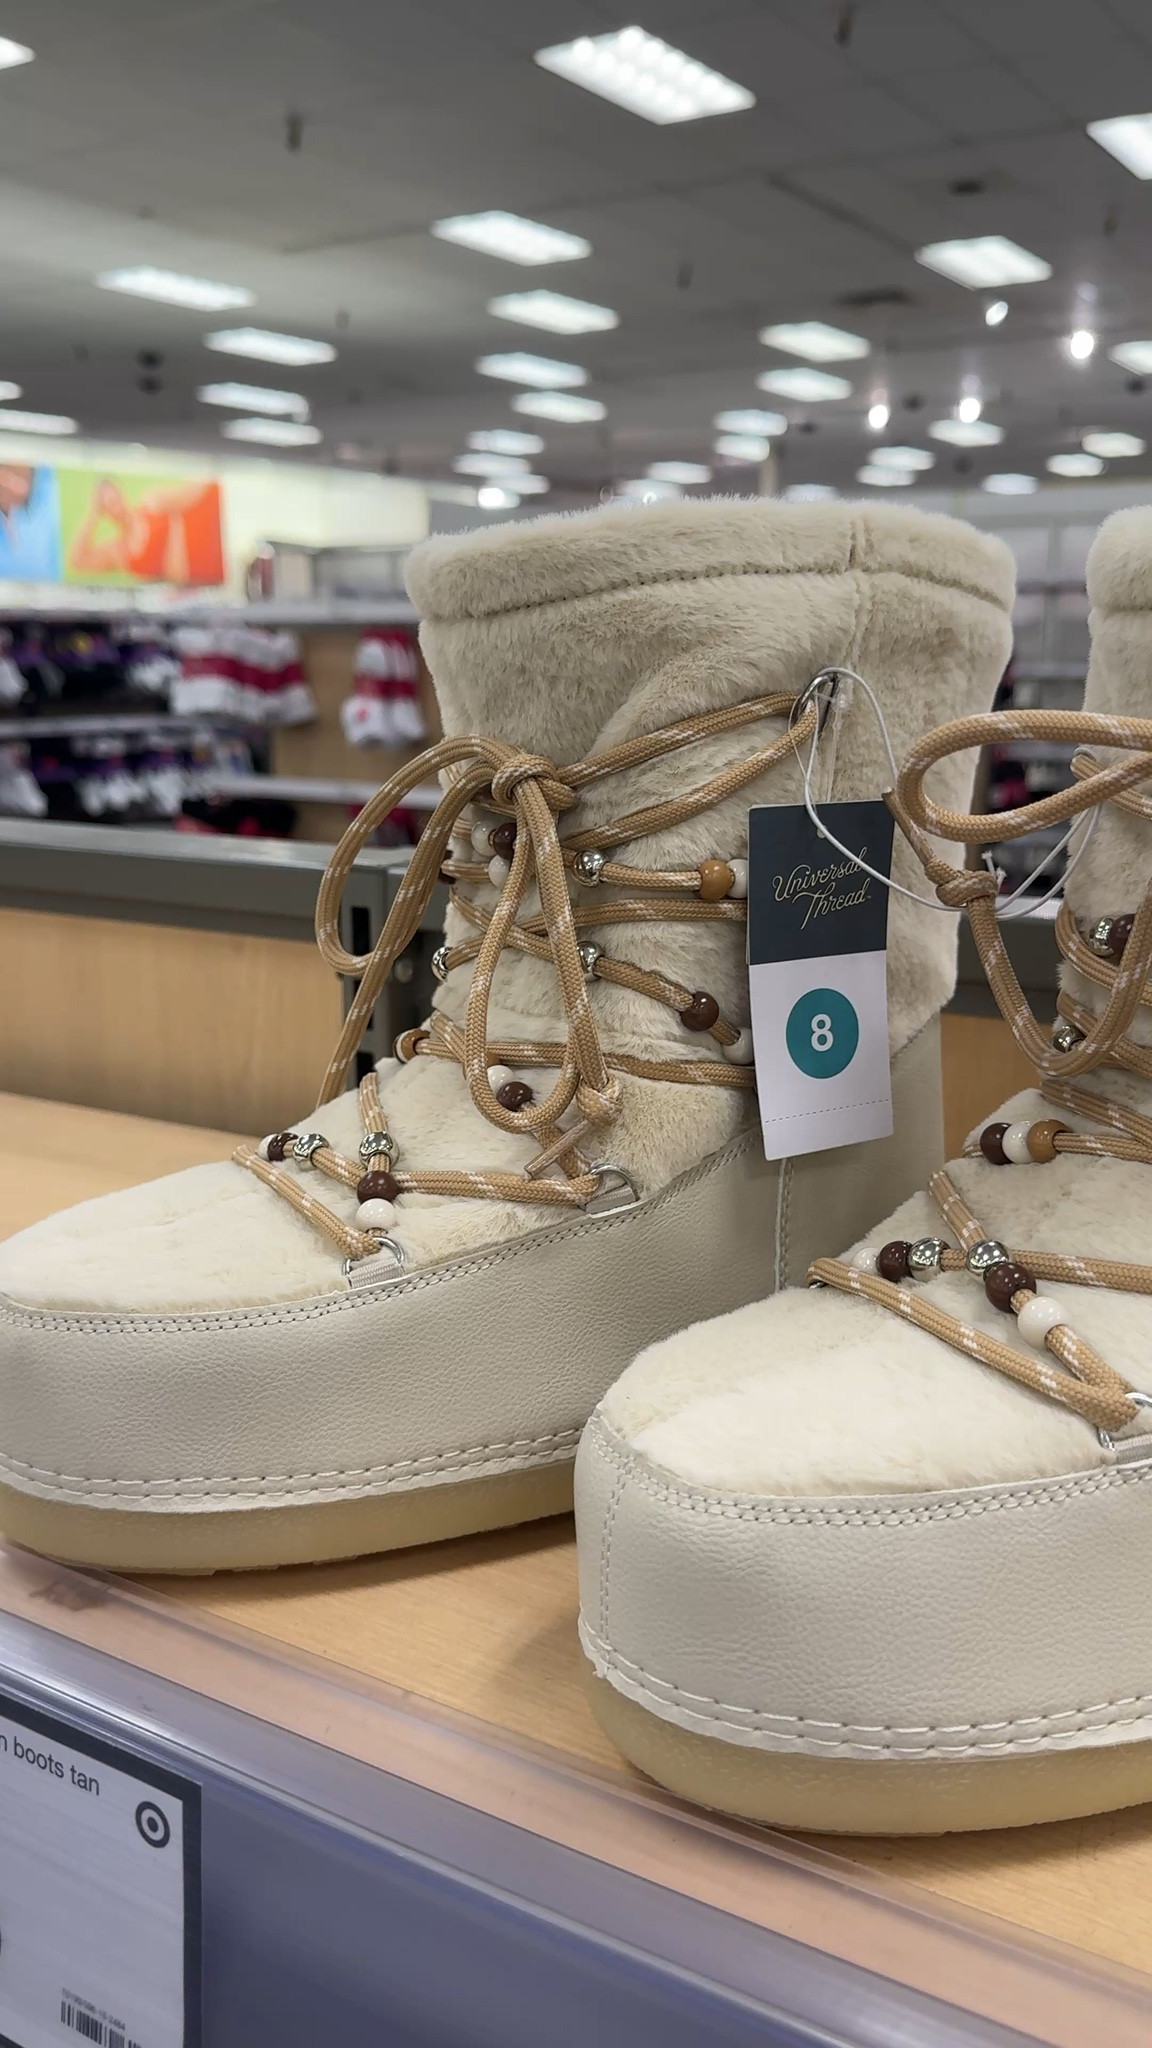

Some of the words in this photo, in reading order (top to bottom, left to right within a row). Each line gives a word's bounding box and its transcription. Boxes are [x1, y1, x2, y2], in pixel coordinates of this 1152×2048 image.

[772, 847, 868, 901] Universal
[792, 877, 871, 930] Thread
[811, 1013, 834, 1051] 8
[14, 1735, 65, 1779] boots
[70, 1765, 100, 1796] tan
